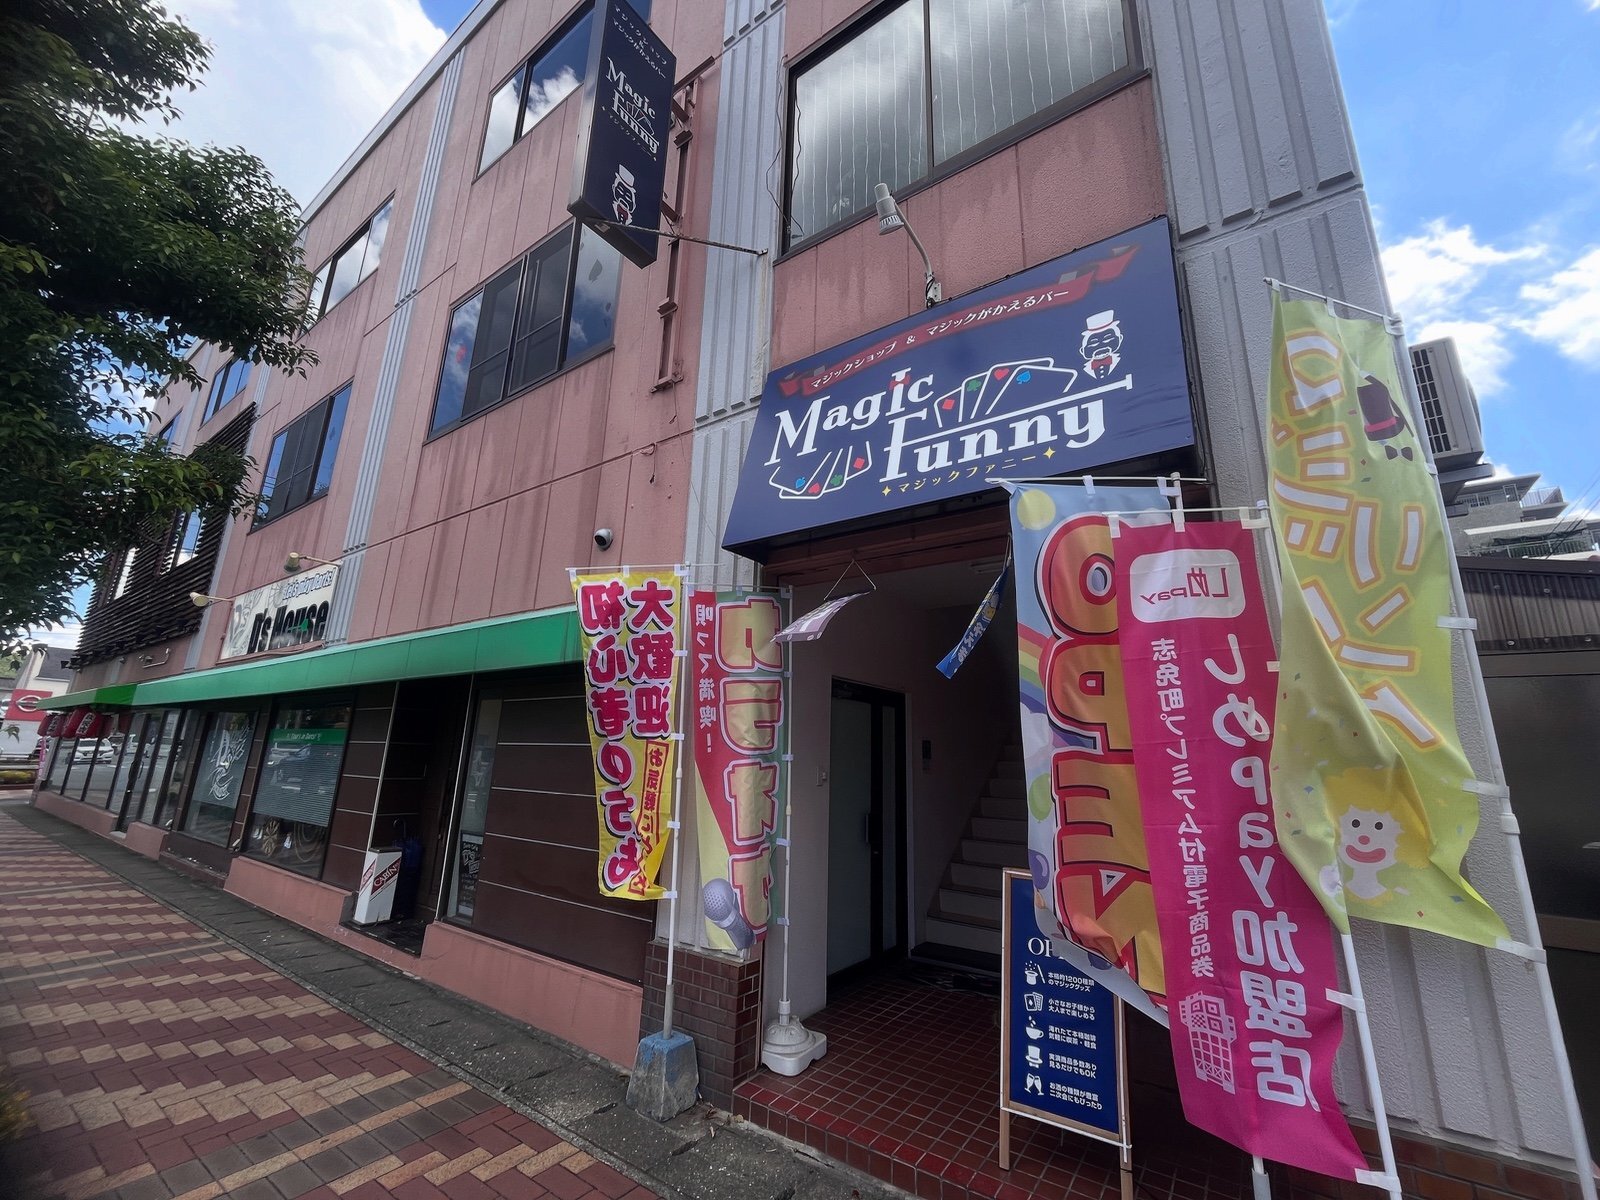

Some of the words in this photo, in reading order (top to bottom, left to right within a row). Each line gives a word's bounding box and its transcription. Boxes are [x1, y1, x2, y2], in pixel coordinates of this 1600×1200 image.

[606, 56, 656, 119] Magic
[611, 89, 659, 154] Funny
[811, 340, 898, 389] マジックショップ
[906, 334, 917, 345] &
[926, 289, 1070, 337] マジックがかえるバー
[764, 366, 935, 467] Magic
[879, 374, 1133, 484] Funny
[897, 452, 1039, 494] マジックファニー
[268, 600, 330, 651] House
[1048, 1006, 1095, 1021] 大人まで楽しめる
